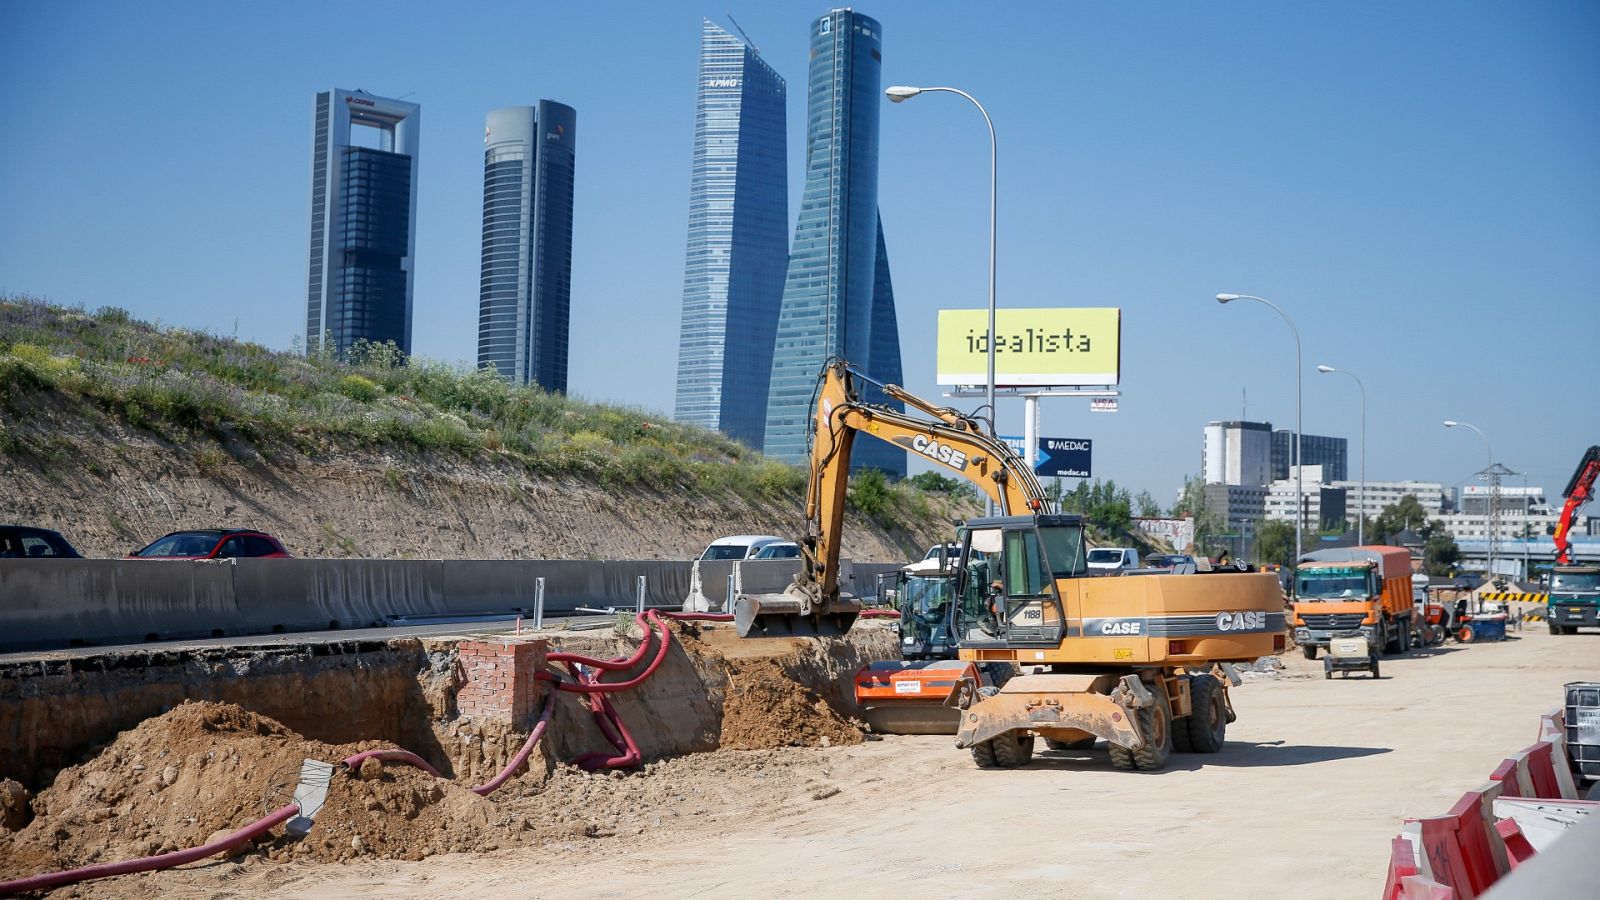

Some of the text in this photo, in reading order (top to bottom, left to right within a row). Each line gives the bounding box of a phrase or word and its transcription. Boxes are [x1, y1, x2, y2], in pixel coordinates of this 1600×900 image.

[709, 79, 738, 88] KPMG
[966, 328, 1091, 353] idealista
[912, 433, 967, 470] CASE
[1054, 440, 1090, 451] MEDAC
[1023, 609, 1041, 619] 1188
[1216, 611, 1266, 631] CASE
[1101, 622, 1141, 635] CASE
